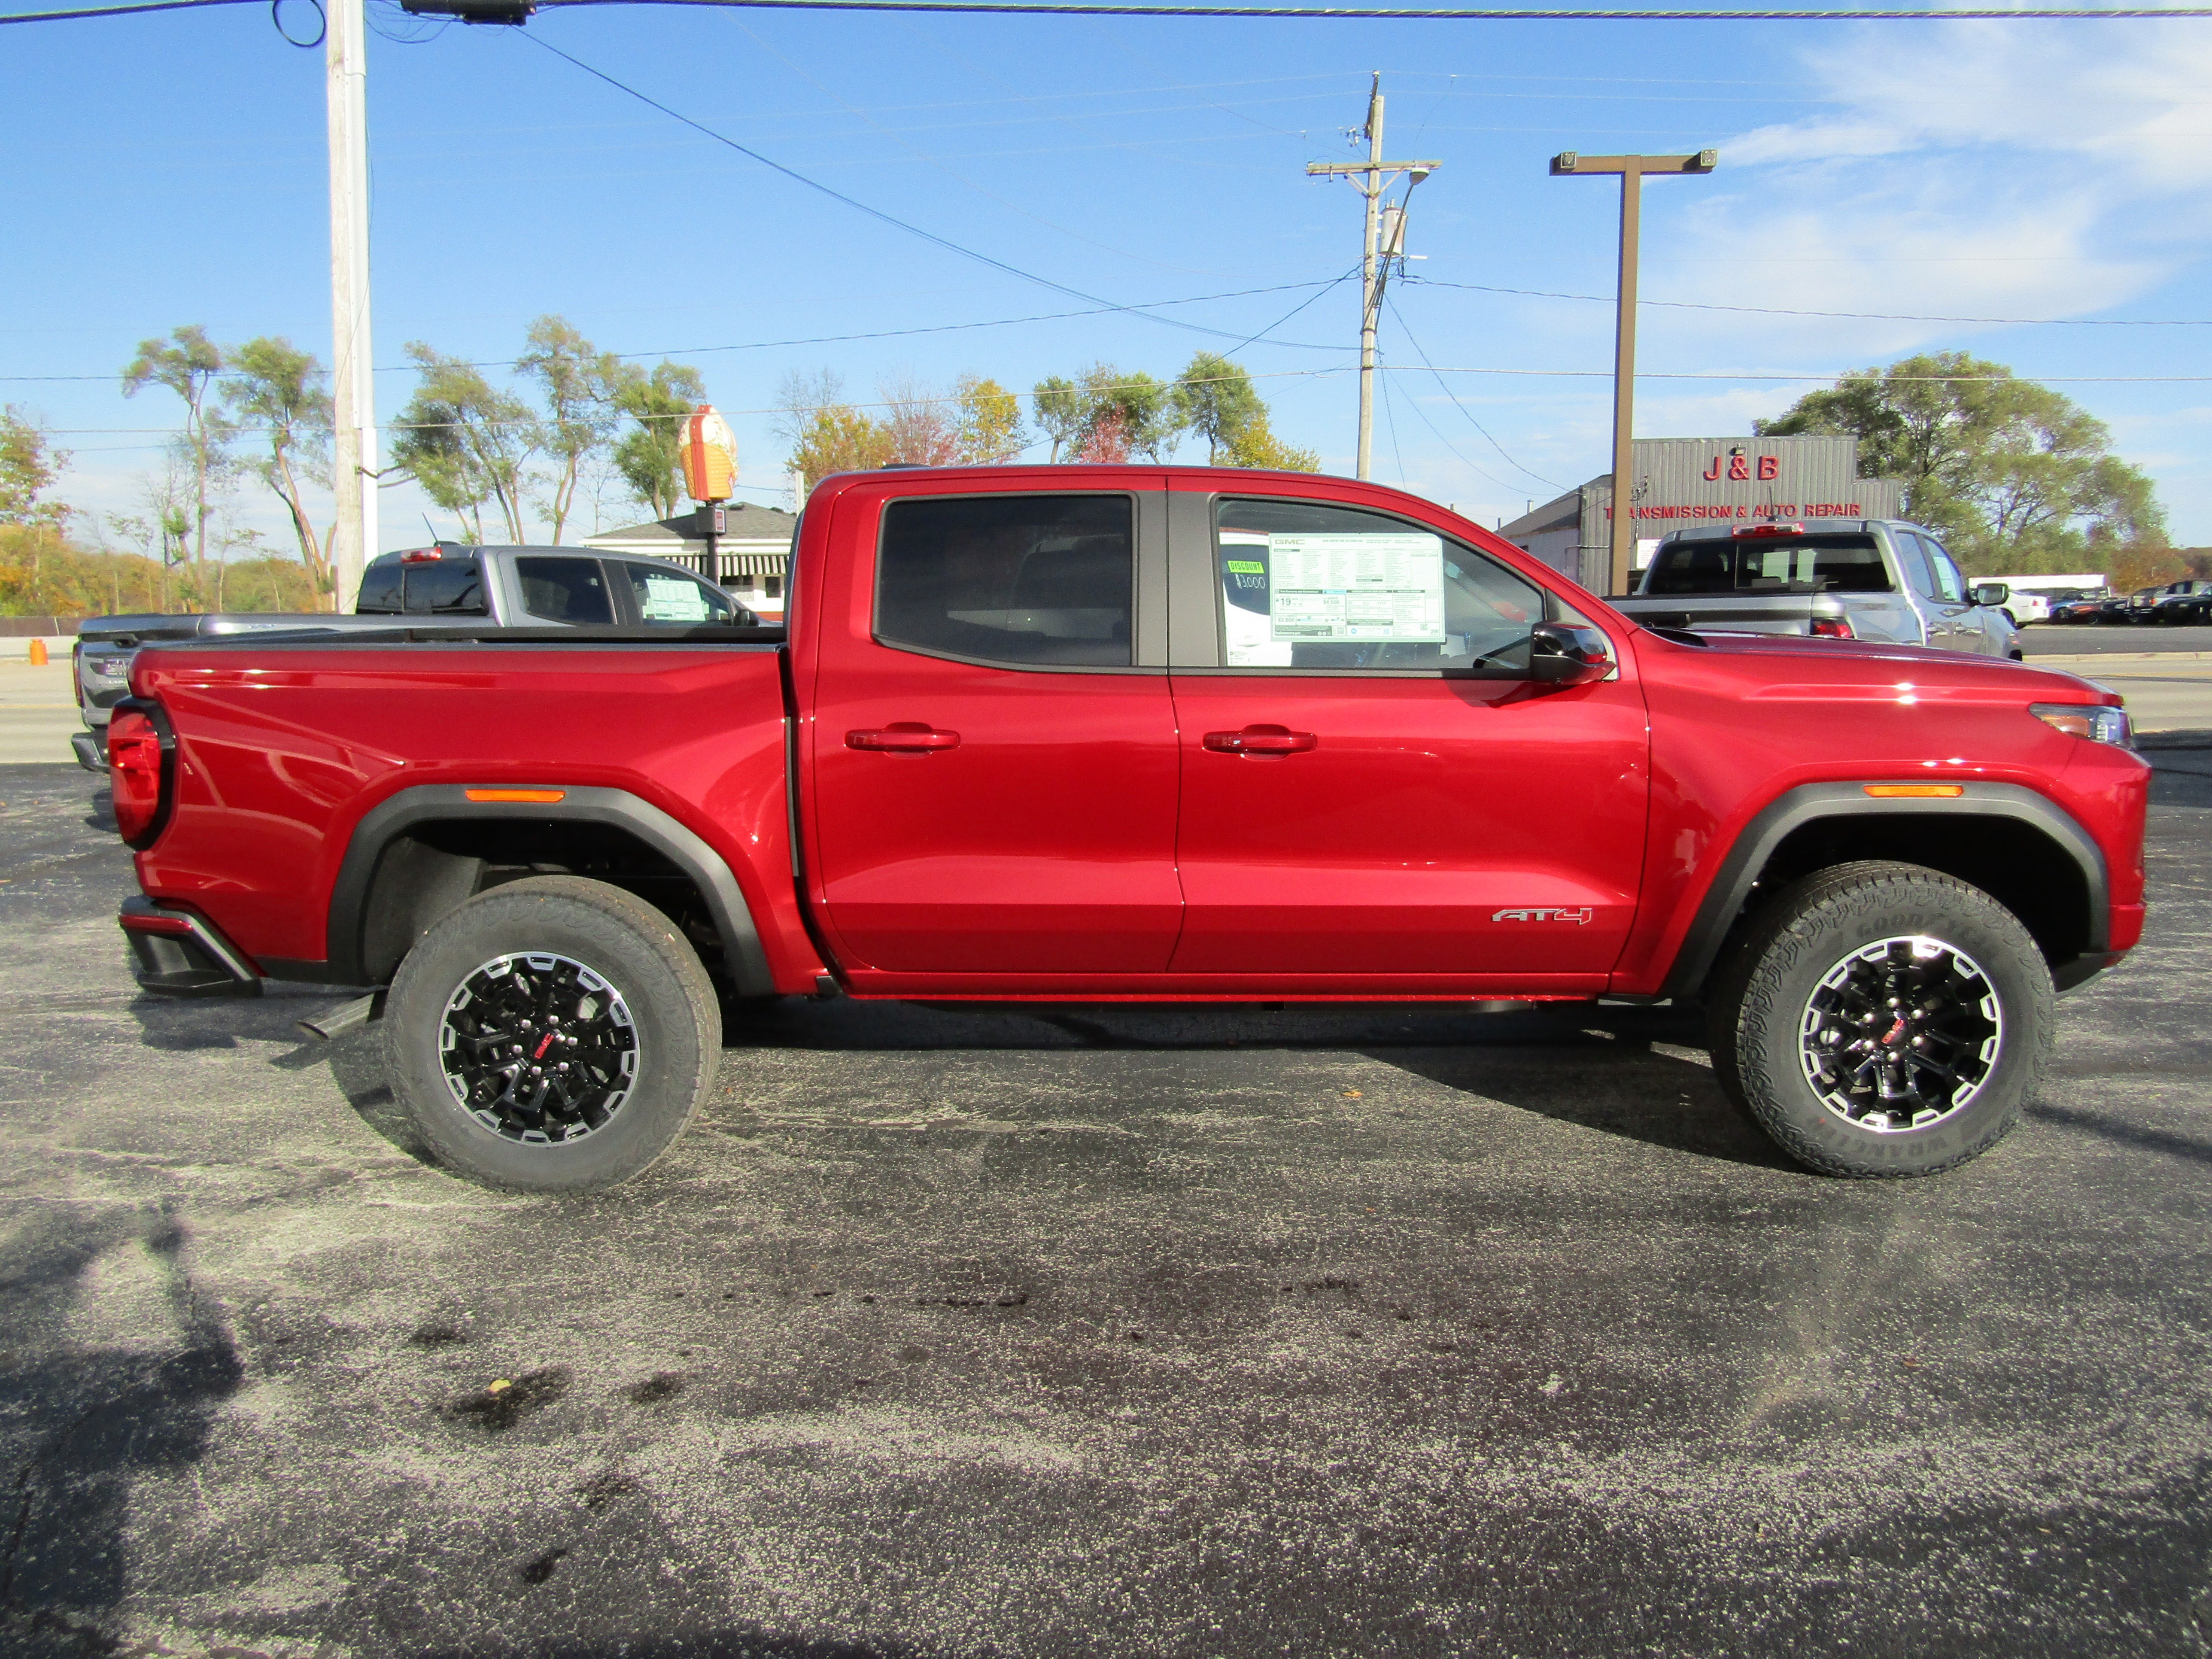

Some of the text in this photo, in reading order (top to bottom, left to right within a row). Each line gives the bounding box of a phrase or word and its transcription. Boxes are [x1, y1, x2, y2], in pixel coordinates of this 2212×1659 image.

[1704, 455, 1780, 480] J & B
[1604, 503, 1860, 520] TANSMISSION & AUTO REPAIR
[1231, 562, 1261, 571] DISCOUNT
[1492, 908, 1592, 925] AT4
[1881, 1019, 1904, 1045] GMC
[535, 1033, 554, 1059] GMC
